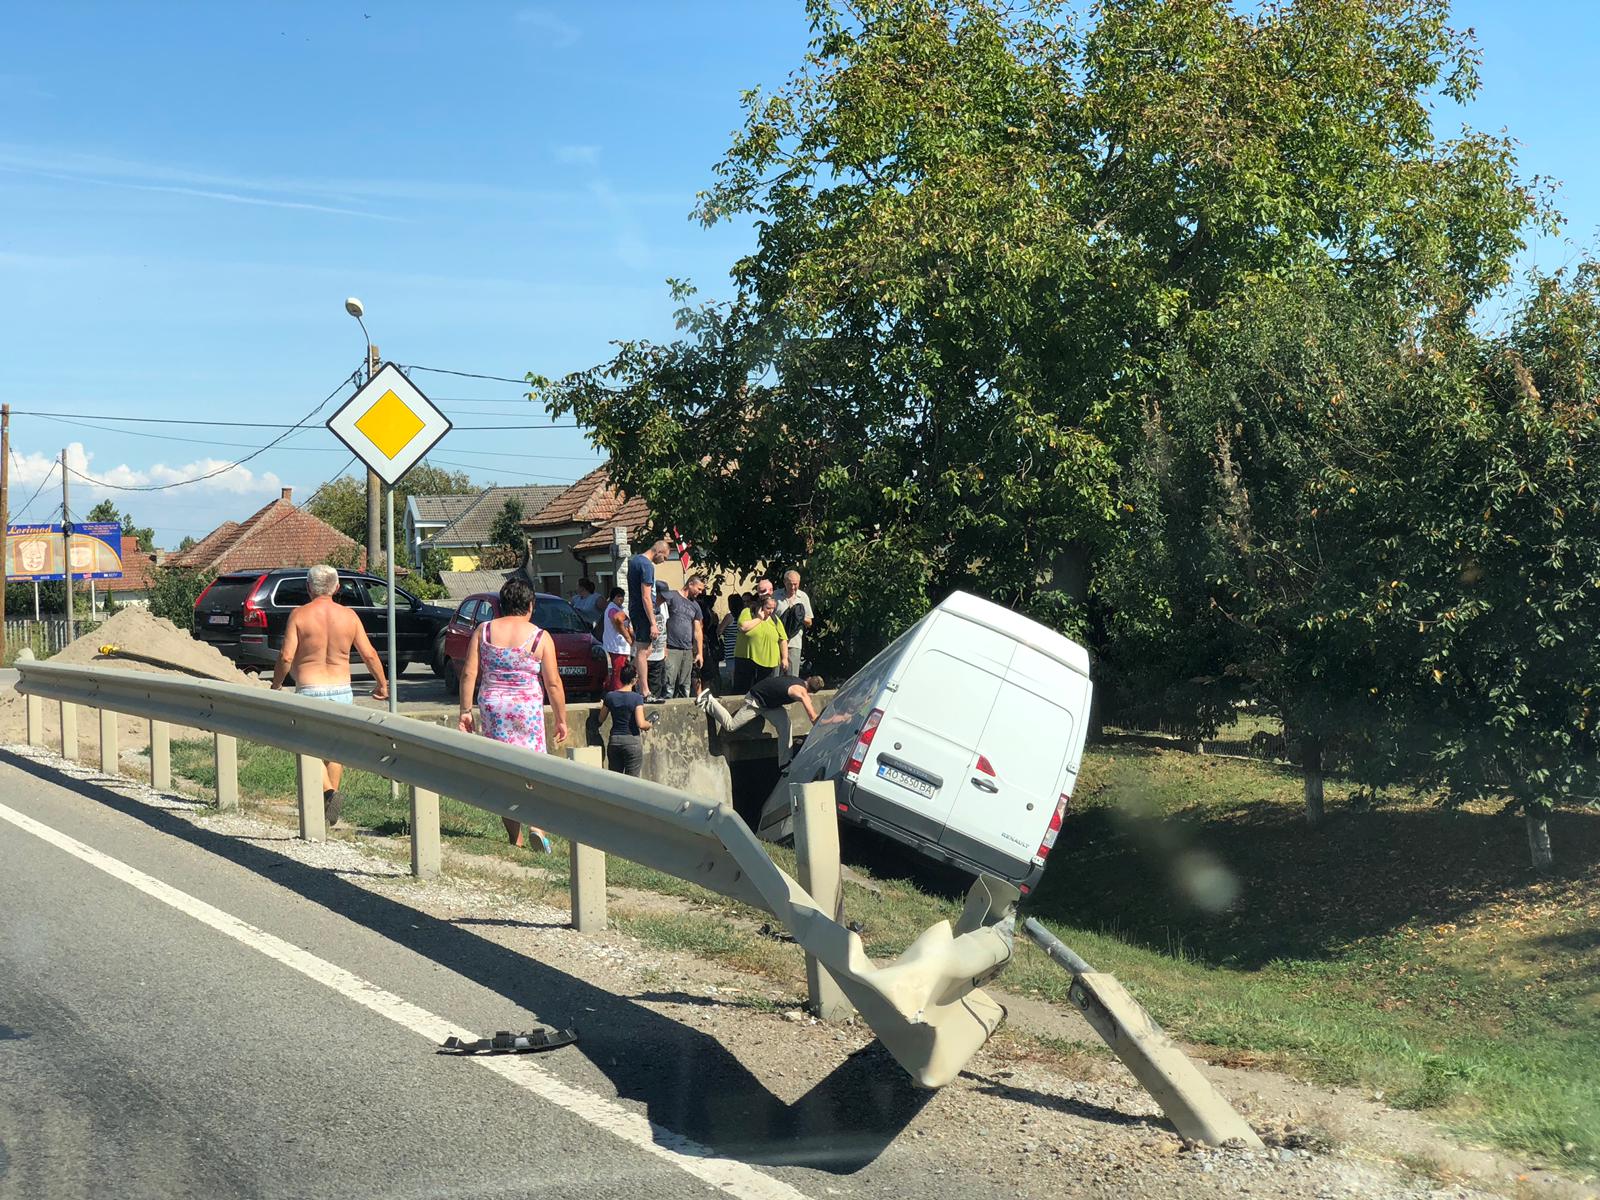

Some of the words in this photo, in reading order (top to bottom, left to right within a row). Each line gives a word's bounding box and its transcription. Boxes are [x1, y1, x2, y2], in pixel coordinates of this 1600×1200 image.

[886, 767, 899, 779] AO
[899, 772, 920, 788] 5650
[919, 780, 933, 795] BA
